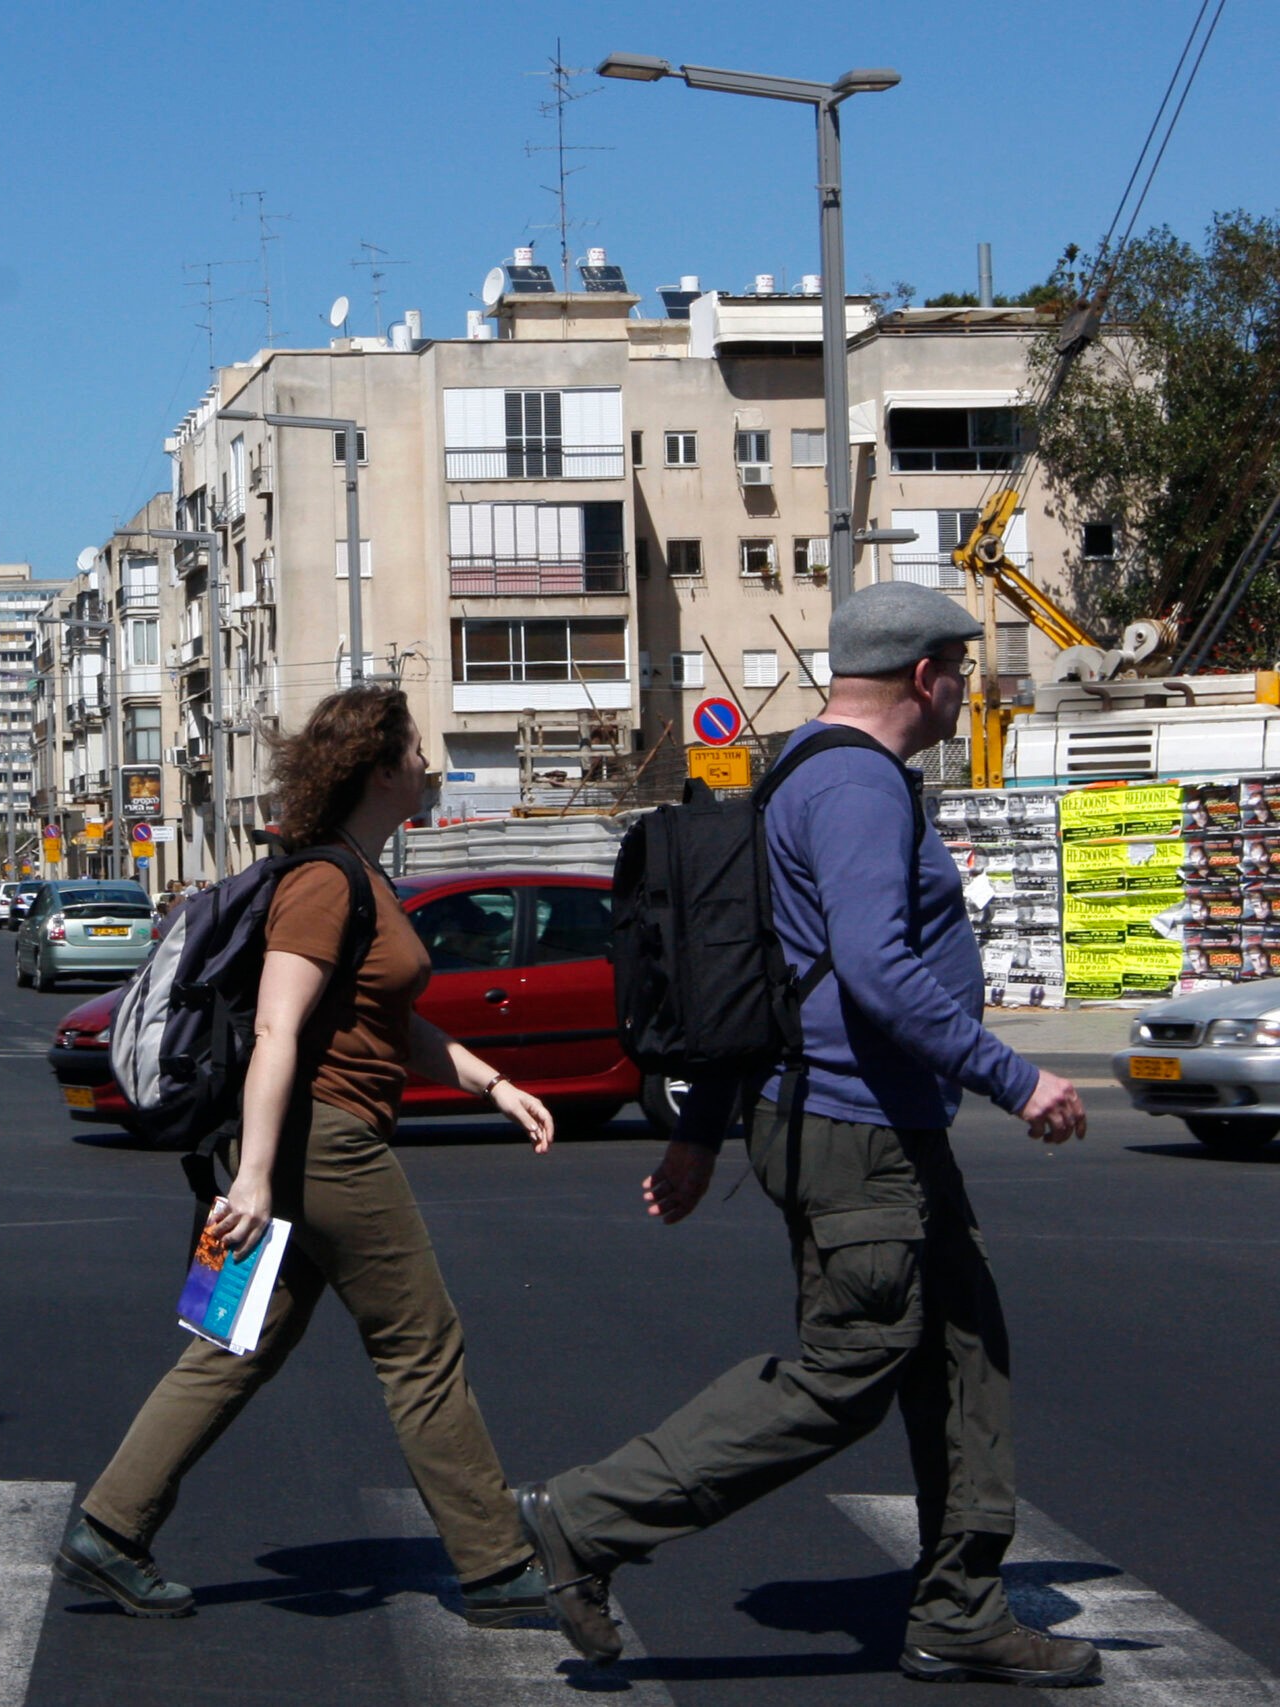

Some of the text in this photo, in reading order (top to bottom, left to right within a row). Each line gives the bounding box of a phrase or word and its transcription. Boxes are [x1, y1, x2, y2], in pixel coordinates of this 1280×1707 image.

[1062, 795, 1108, 811] HEEDOOSH
[1124, 789, 1167, 805] HEEDOOSH
[1066, 848, 1111, 863] HEEDOOSH
[1066, 949, 1110, 964] HEEDOOSH
